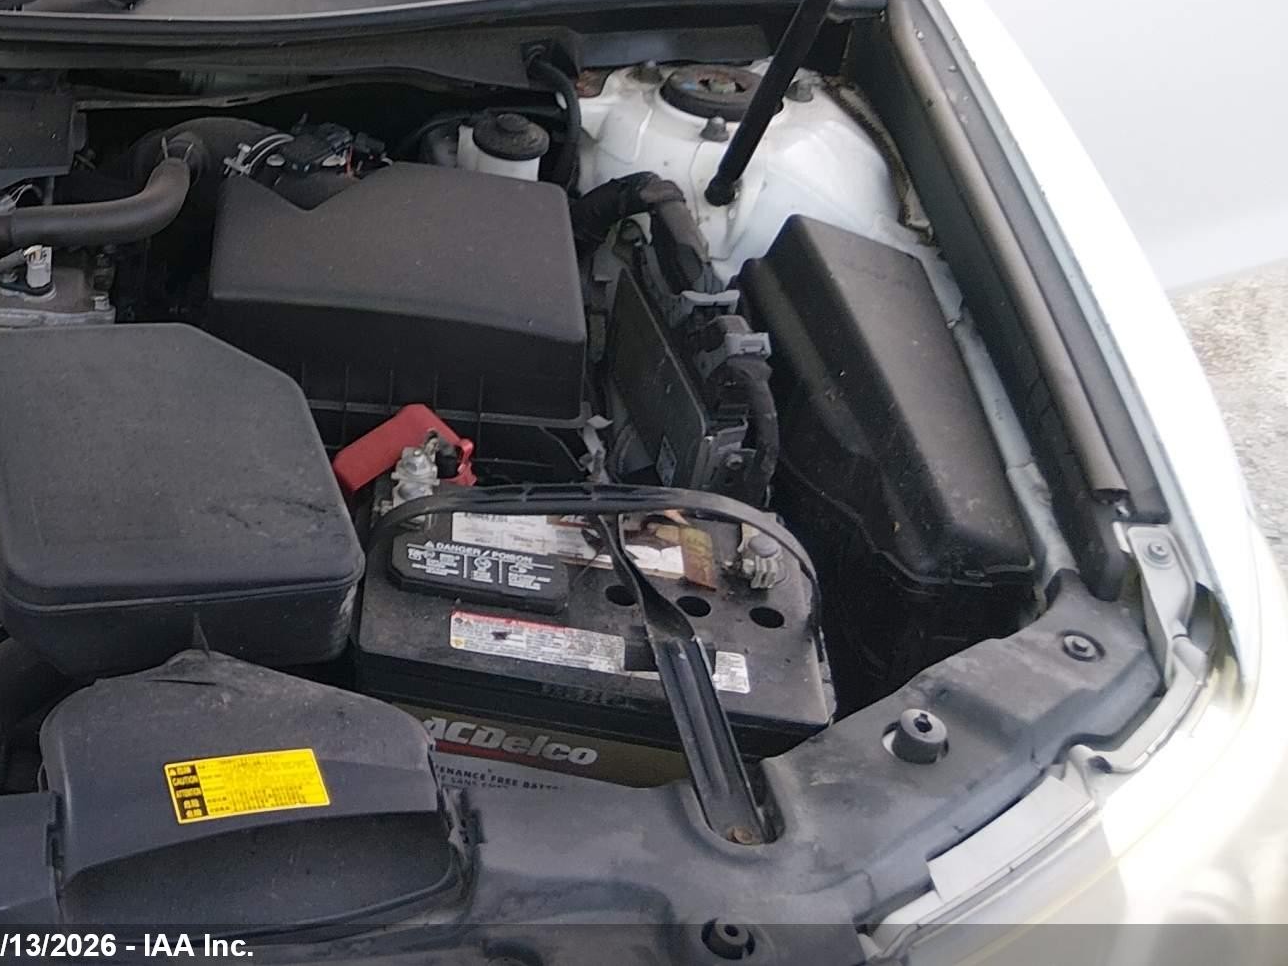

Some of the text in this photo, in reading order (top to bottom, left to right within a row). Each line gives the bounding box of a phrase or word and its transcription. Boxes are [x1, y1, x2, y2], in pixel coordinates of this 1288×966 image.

[436, 542, 481, 556] DANGER
[491, 551, 533, 564] POISON
[423, 716, 598, 765] ACDelco
[490, 774, 518, 786] FREE
